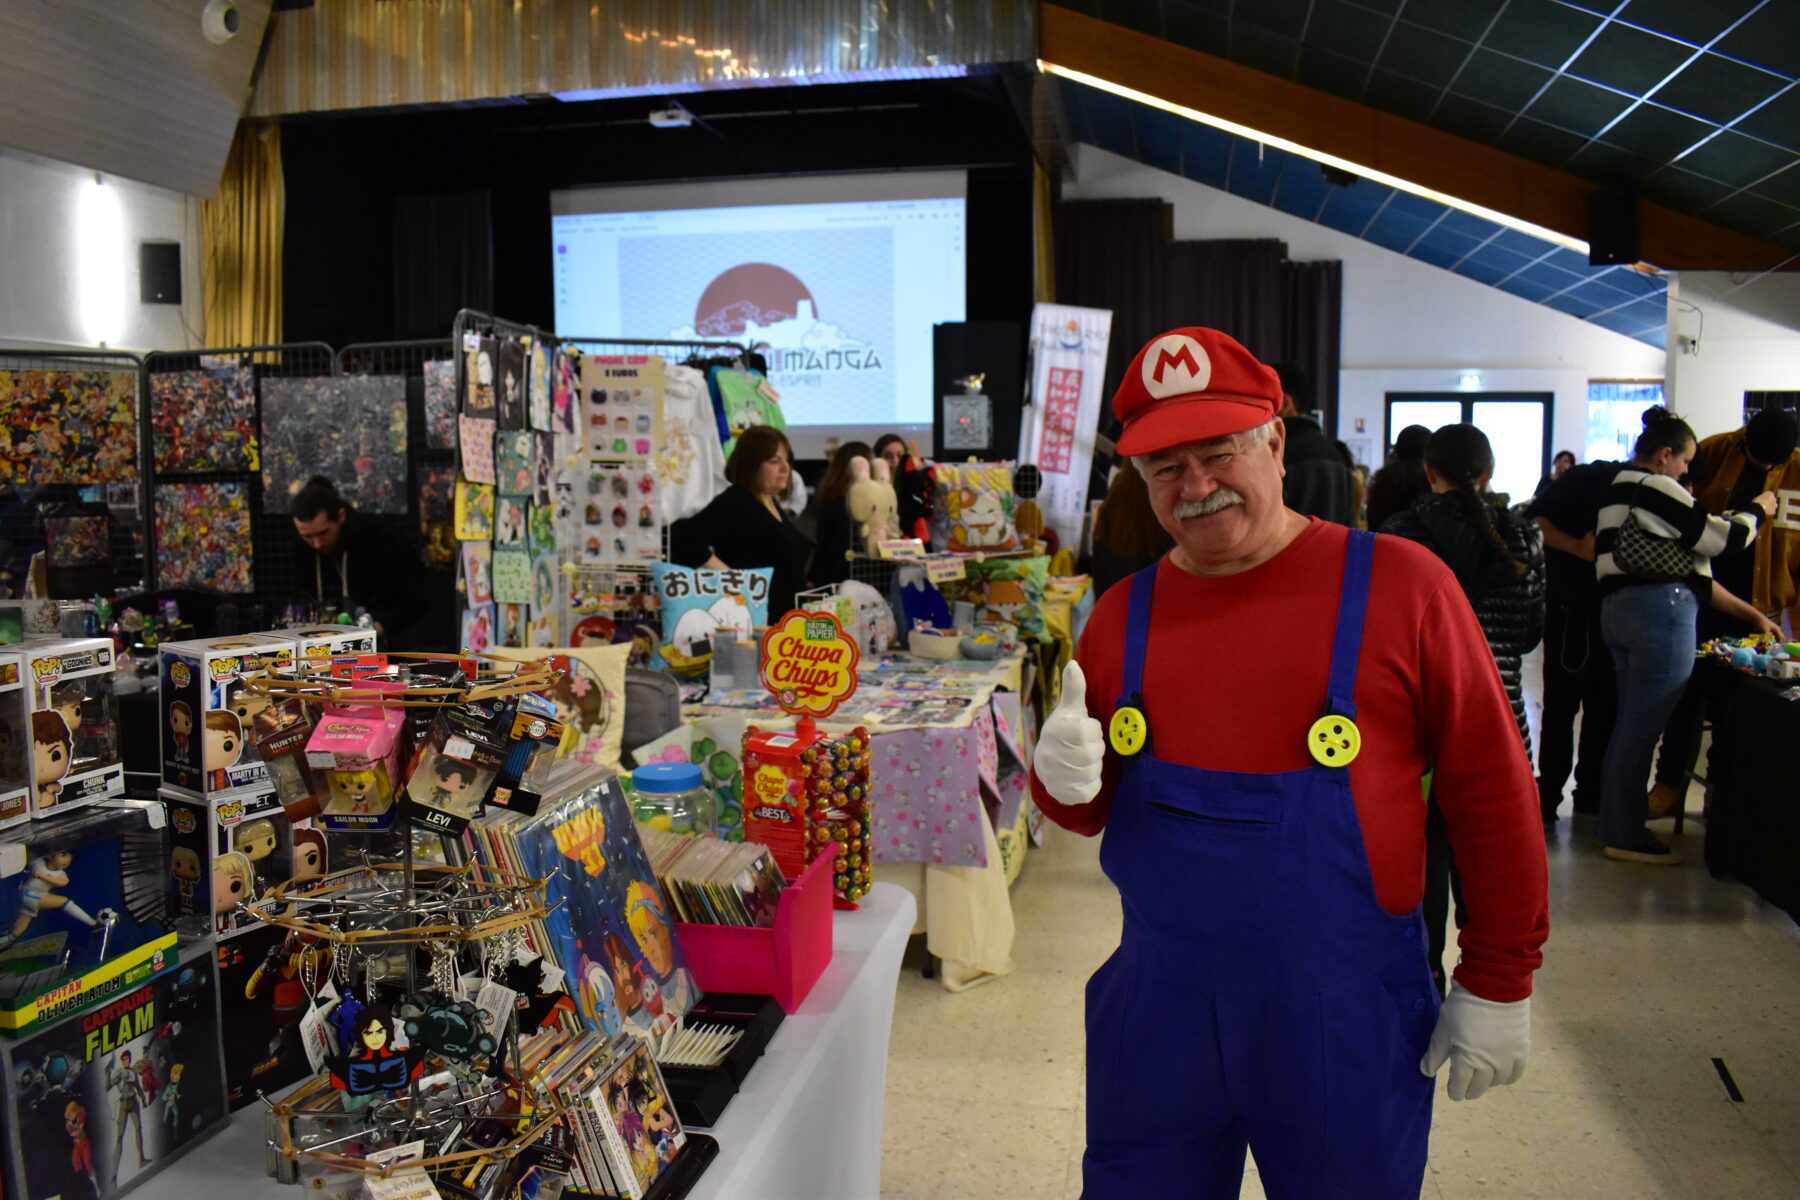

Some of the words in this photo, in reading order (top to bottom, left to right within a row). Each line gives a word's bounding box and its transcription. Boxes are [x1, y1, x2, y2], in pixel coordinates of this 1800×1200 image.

[1152, 343, 1200, 385] M
[662, 570, 768, 601] おにぎり
[777, 636, 844, 667] Chupa
[31, 658, 61, 679] POP!
[66, 656, 93, 669] GOONIES
[209, 658, 239, 677] POP!
[772, 659, 839, 692] Chups
[269, 733, 304, 750] HUNTER
[83, 775, 105, 788] CHUNK
[231, 769, 252, 781] MARTY
[758, 774, 785, 785] Chupa
[756, 782, 784, 795] Chups
[216, 802, 244, 822] POP!
[333, 815, 358, 824] SAILOR
[358, 816, 379, 824] MOON
[426, 811, 452, 828] LEVI
[761, 806, 786, 820] BEST
[38, 993, 85, 1023] OLIVER
[88, 976, 121, 1001] ATOM
[83, 986, 155, 1033] CAPITAINE
[86, 1000, 155, 1064] FLAM
